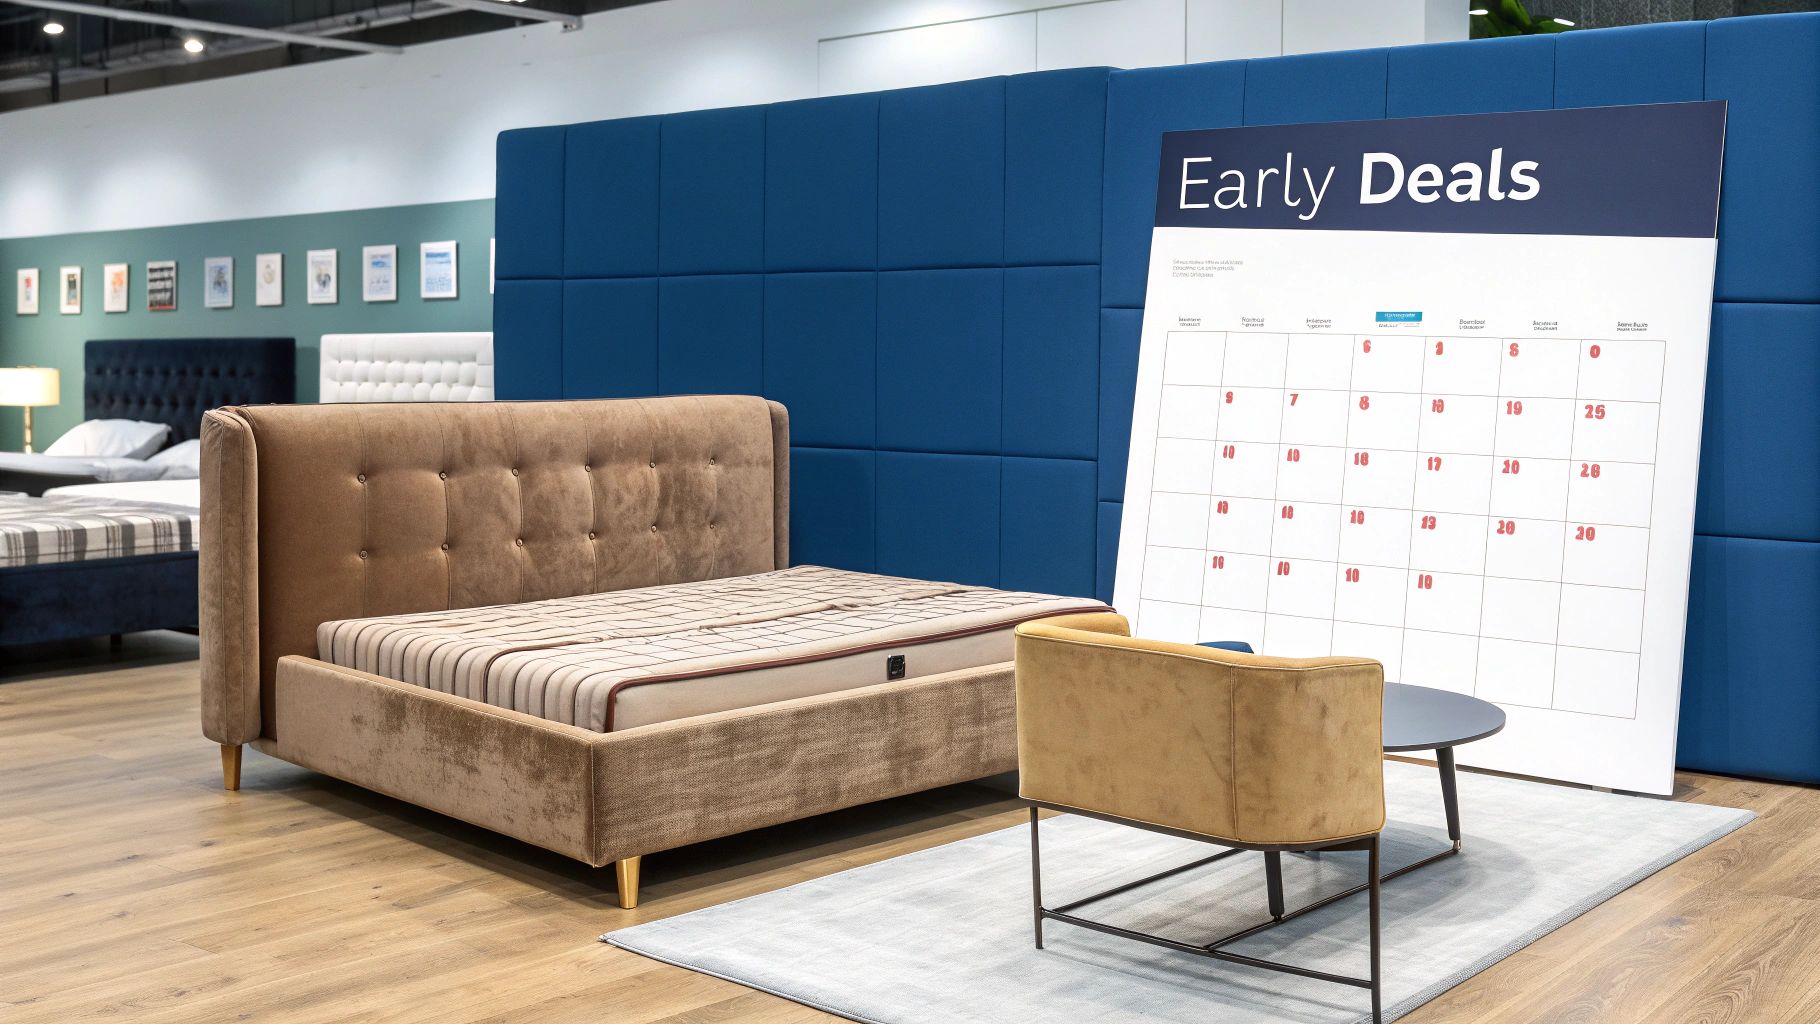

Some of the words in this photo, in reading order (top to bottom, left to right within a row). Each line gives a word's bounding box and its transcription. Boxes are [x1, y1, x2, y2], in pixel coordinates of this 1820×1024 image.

[1180, 152, 1336, 221] Early
[1359, 147, 1541, 205] Deals
[1290, 393, 1299, 407] 7
